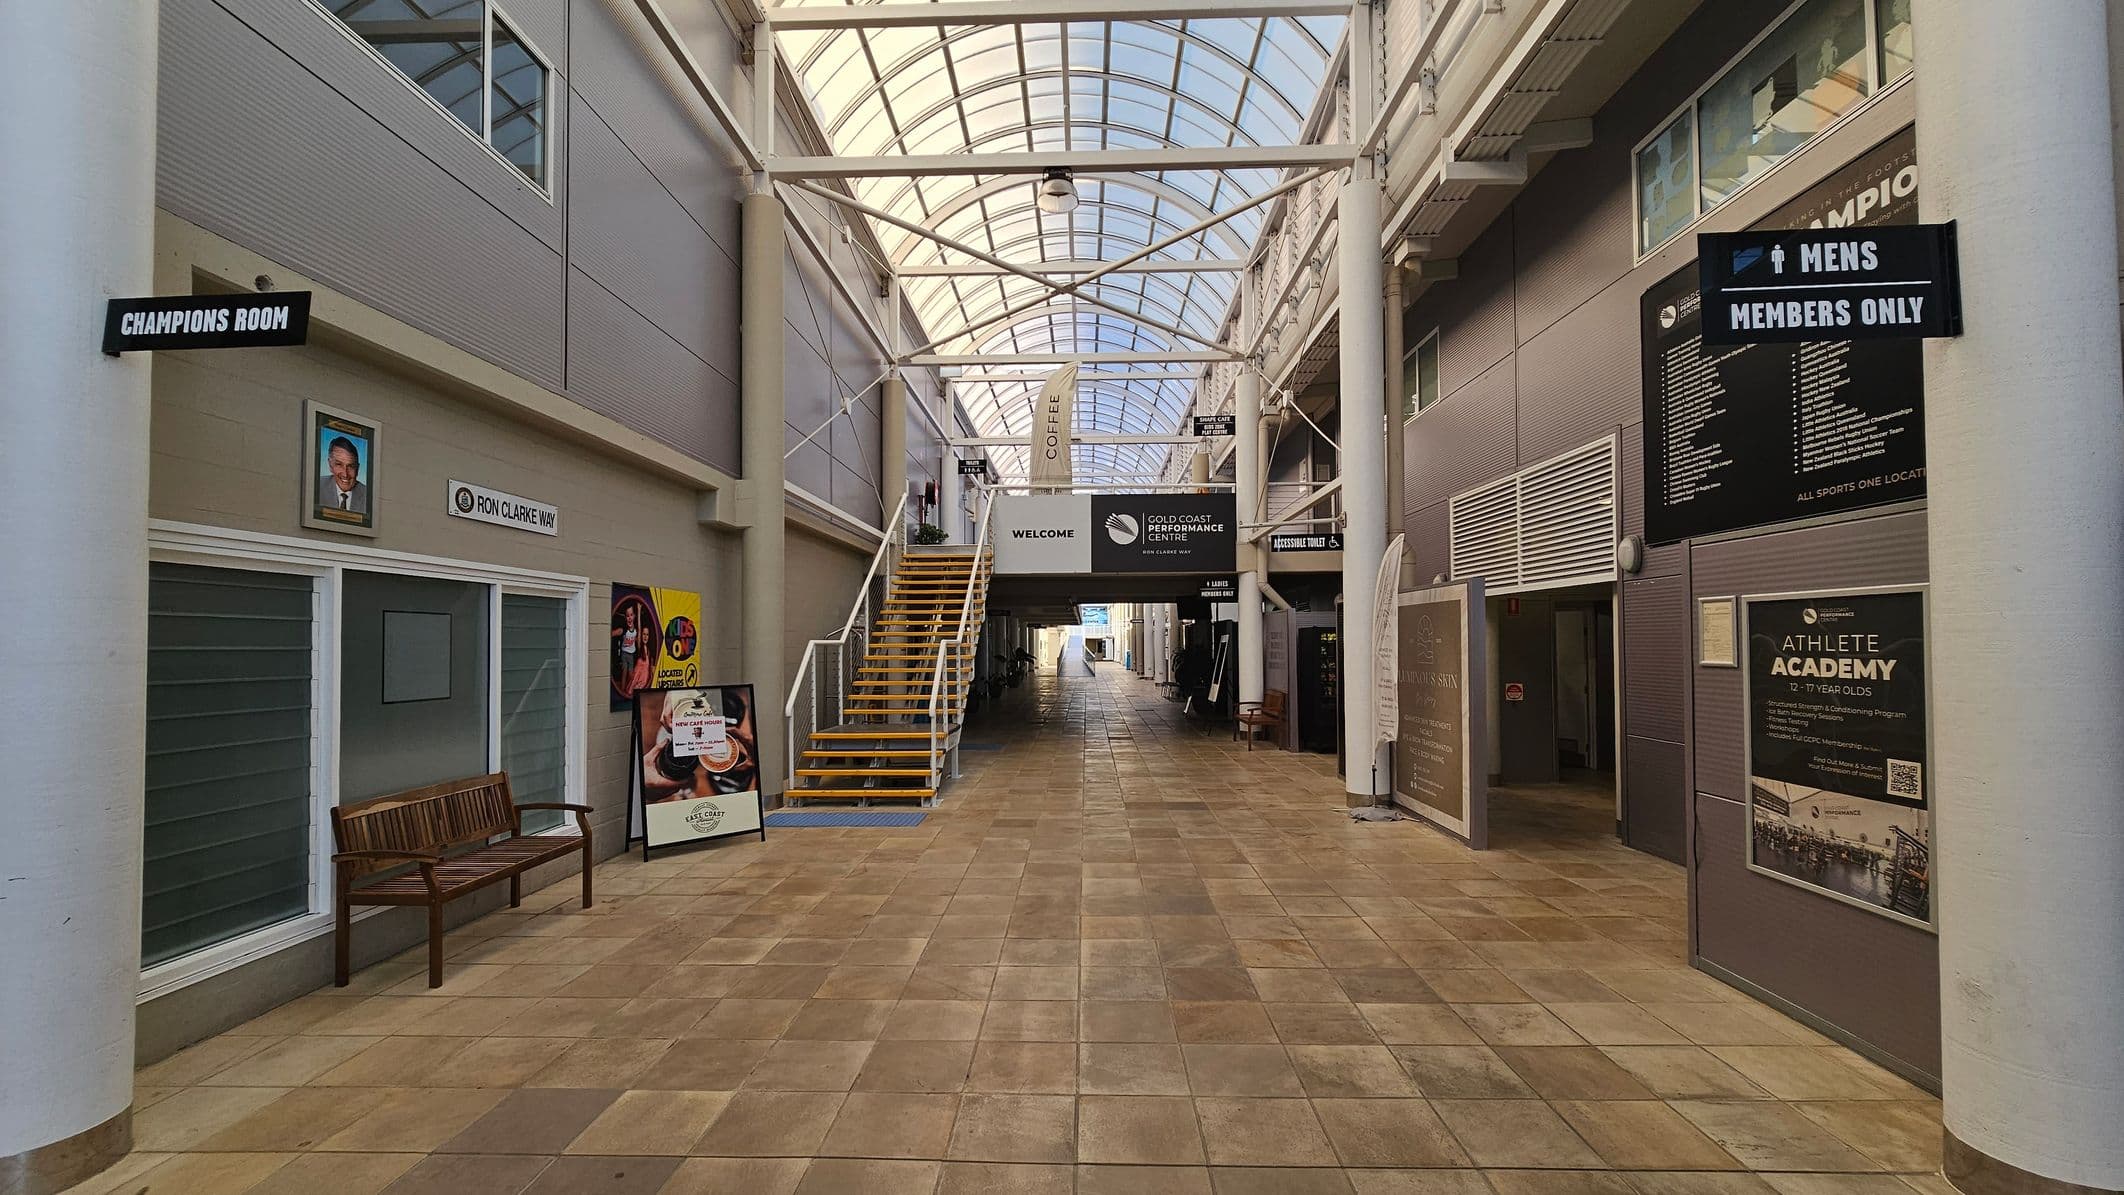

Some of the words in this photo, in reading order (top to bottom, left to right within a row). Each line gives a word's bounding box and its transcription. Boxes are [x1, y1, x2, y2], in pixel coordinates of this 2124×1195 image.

[1838, 182, 1860, 199] THE
[1800, 241, 1878, 273] MENS
[121, 308, 229, 336] CHAMPIONS
[234, 306, 289, 331] ROOM
[1731, 299, 1851, 330] MEMBERS
[1861, 296, 1924, 325] ONLY
[1046, 395, 1060, 460] COFFEE
[1797, 492, 1814, 502] ALL
[1816, 481, 1856, 498] SPORTS
[1858, 476, 1881, 489] ONE
[477, 495, 499, 516] RON
[501, 501, 537, 524] CLARKE
[538, 510, 556, 528] WAY
[1148, 515, 1176, 524] GOLD
[1178, 514, 1211, 523] COAST
[1012, 529, 1075, 539] WELCOME
[1148, 524, 1224, 533] PERFORMANCE
[1148, 533, 1188, 542] CENTRE
[1274, 538, 1306, 548] ACCESSIBLE
[1307, 537, 1325, 547] TOILET
[669, 618, 694, 637] KIDS
[1782, 634, 1879, 652] ATHLETE
[658, 669, 683, 679] LOCATED
[1771, 656, 1897, 681] ACADEMY
[658, 679, 684, 688] UPSTAIRS
[1438, 672, 1458, 689] SKIN
[1789, 683, 1798, 692] 12
[1806, 684, 1814, 693] 17
[1816, 684, 1841, 694] YEAR
[1842, 685, 1872, 697] OLDS
[1798, 703, 1824, 711] Strength
[1830, 705, 1873, 716] Conditioning
[1874, 709, 1907, 719] Program
[1822, 739, 1862, 750] Membership
[685, 813, 703, 823] EAST
